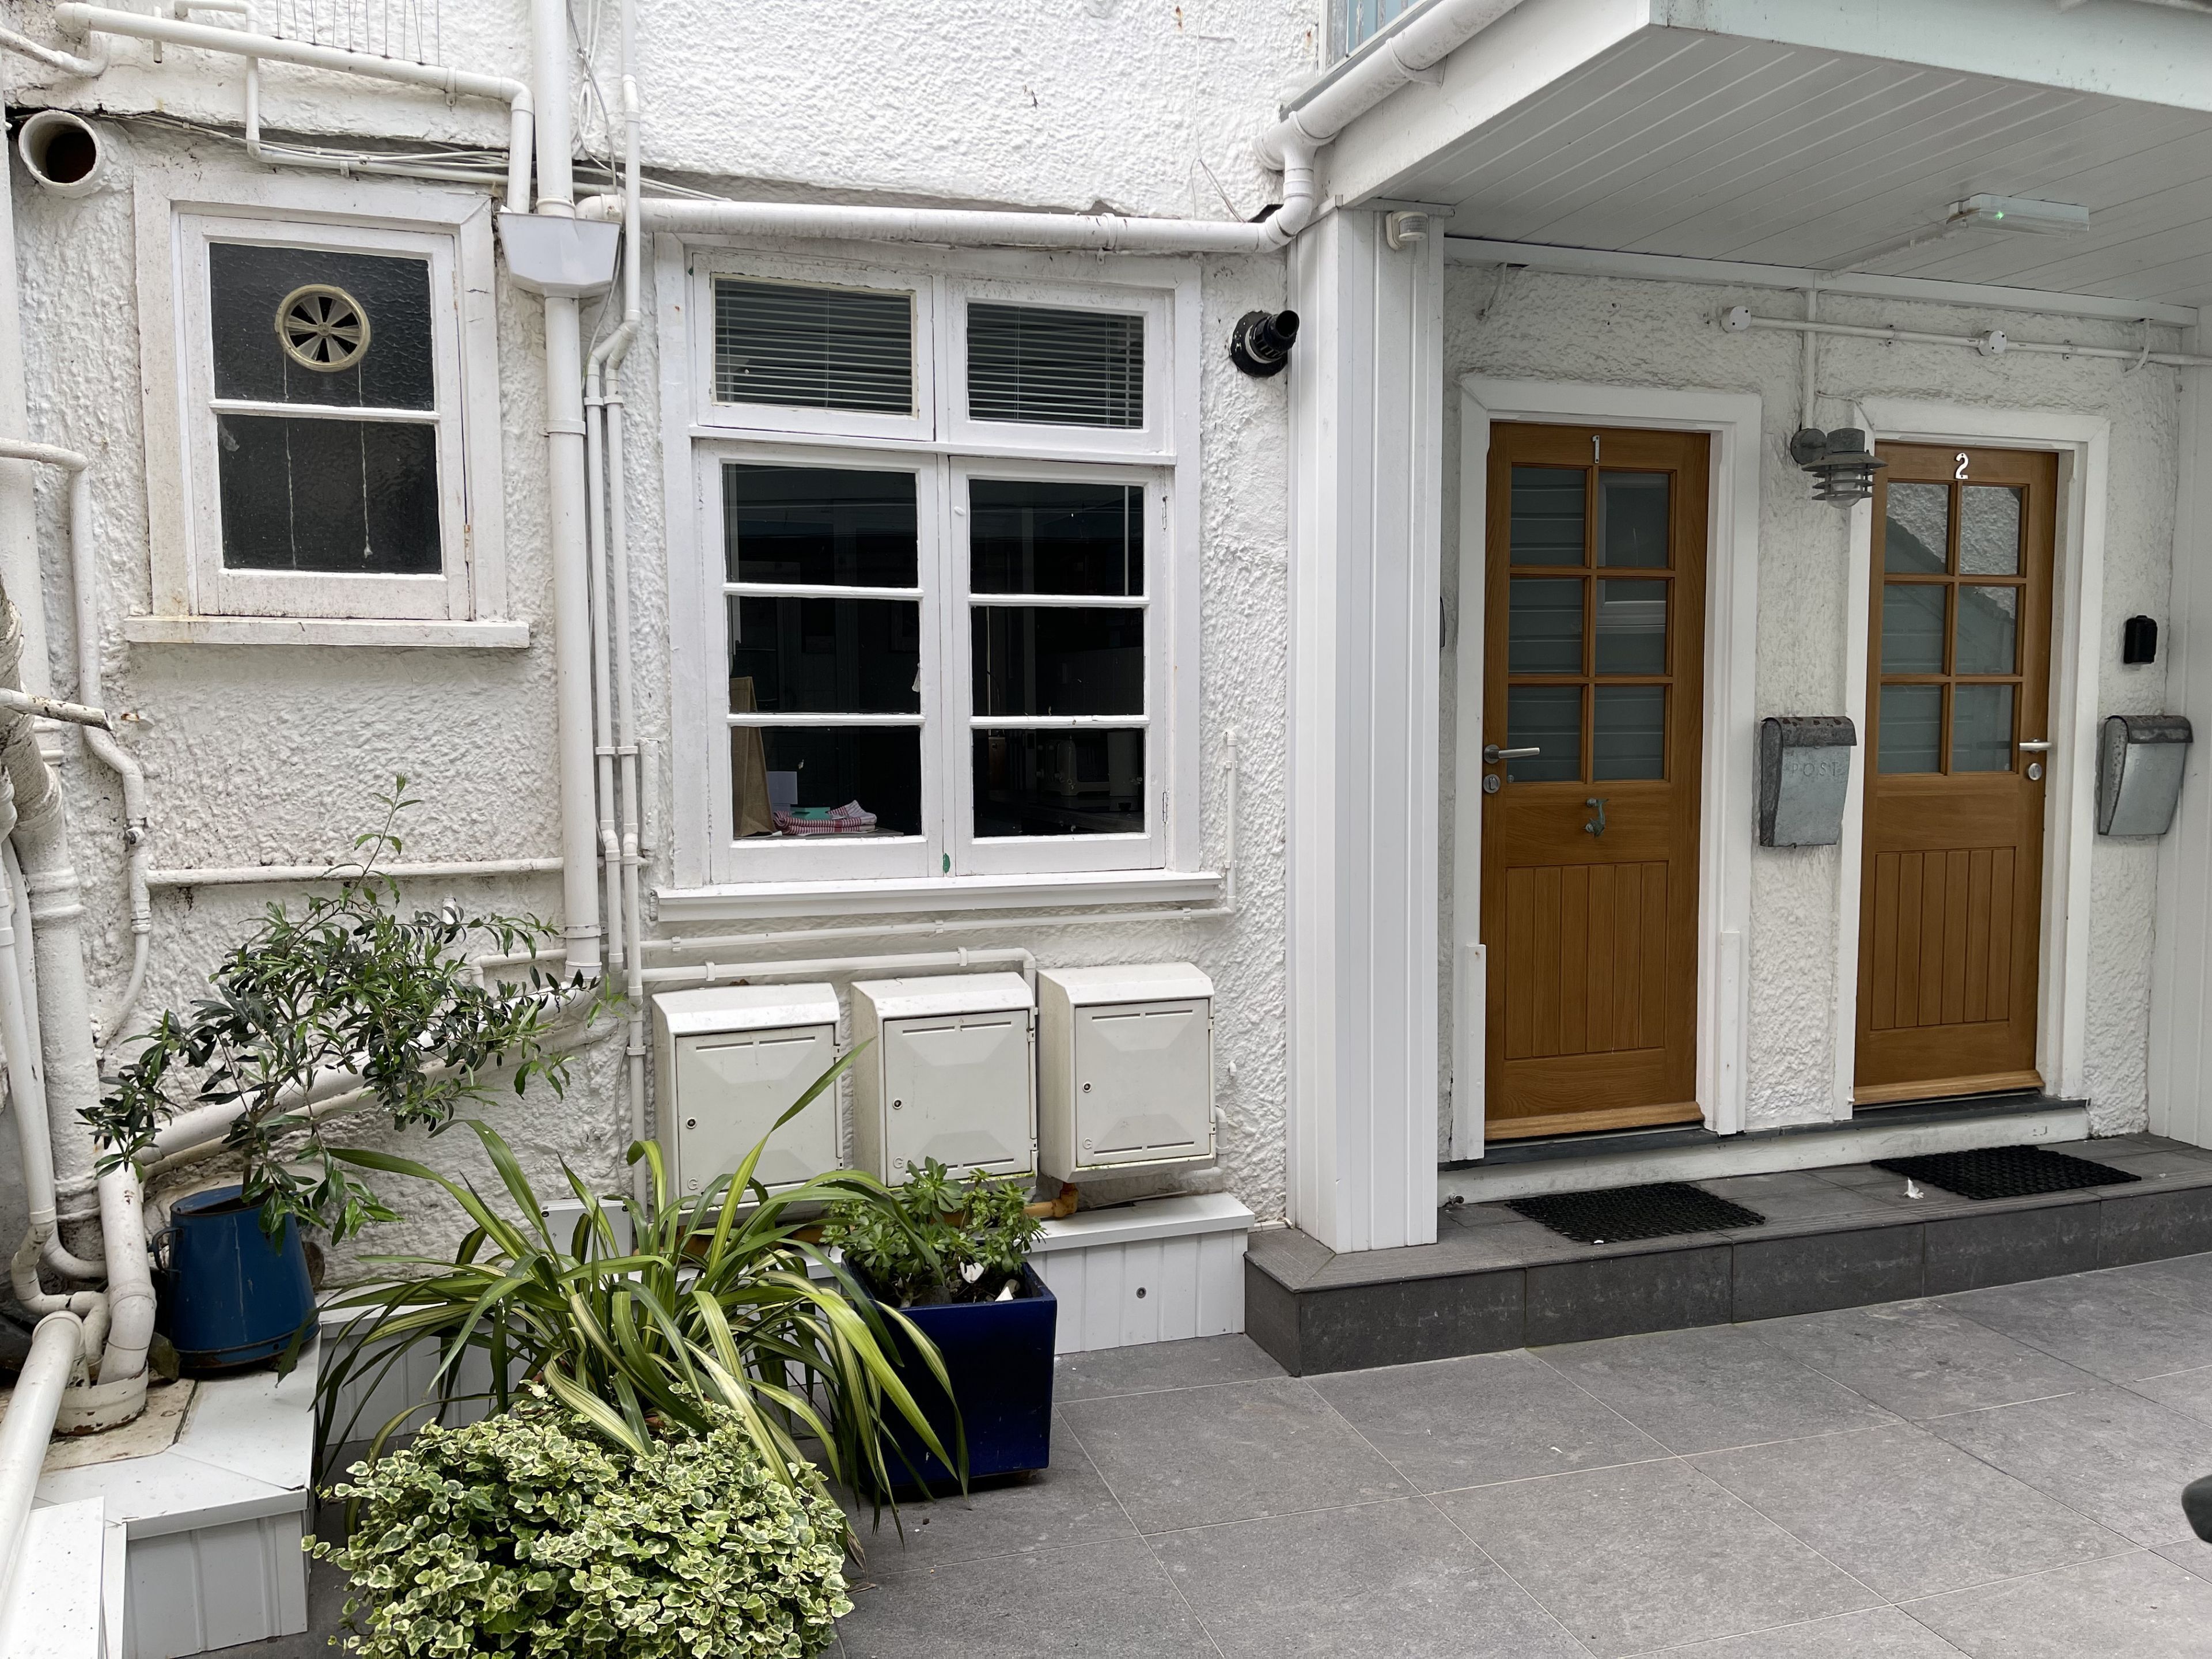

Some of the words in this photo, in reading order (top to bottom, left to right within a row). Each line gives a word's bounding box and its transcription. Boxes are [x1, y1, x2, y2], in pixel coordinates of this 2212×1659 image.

[1592, 435, 1600, 464] 1
[1955, 452, 1969, 479] 2
[1791, 761, 1839, 777] POST
[1083, 1138, 1092, 1150] G
[893, 1156, 903, 1169] G
[687, 1177, 698, 1191] G
